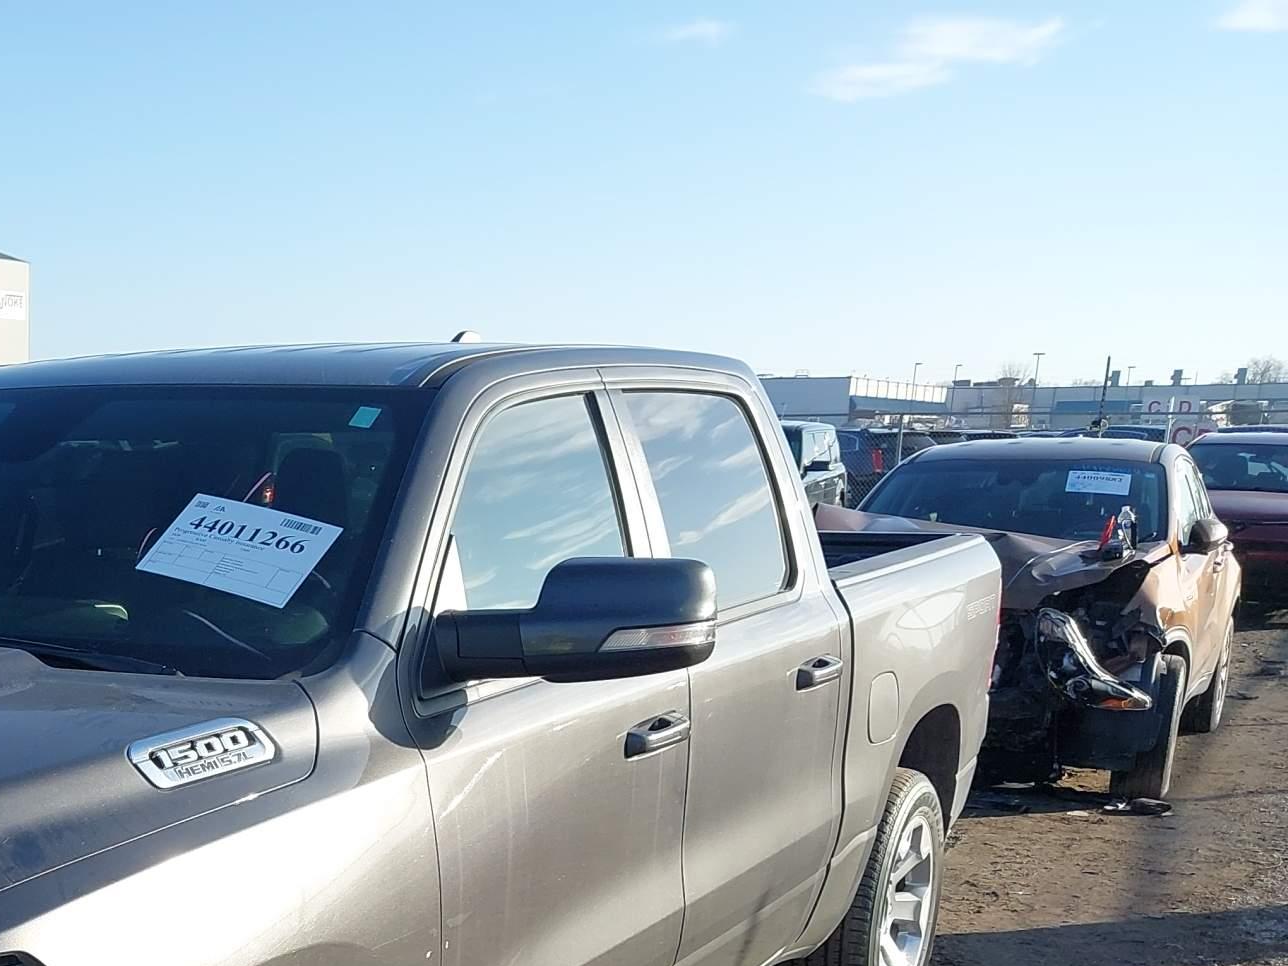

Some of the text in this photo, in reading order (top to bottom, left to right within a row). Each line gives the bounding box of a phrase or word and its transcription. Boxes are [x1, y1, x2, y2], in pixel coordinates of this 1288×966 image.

[188, 514, 312, 555] 44011266
[151, 729, 250, 769] 1500
[176, 755, 220, 779] HEMI
